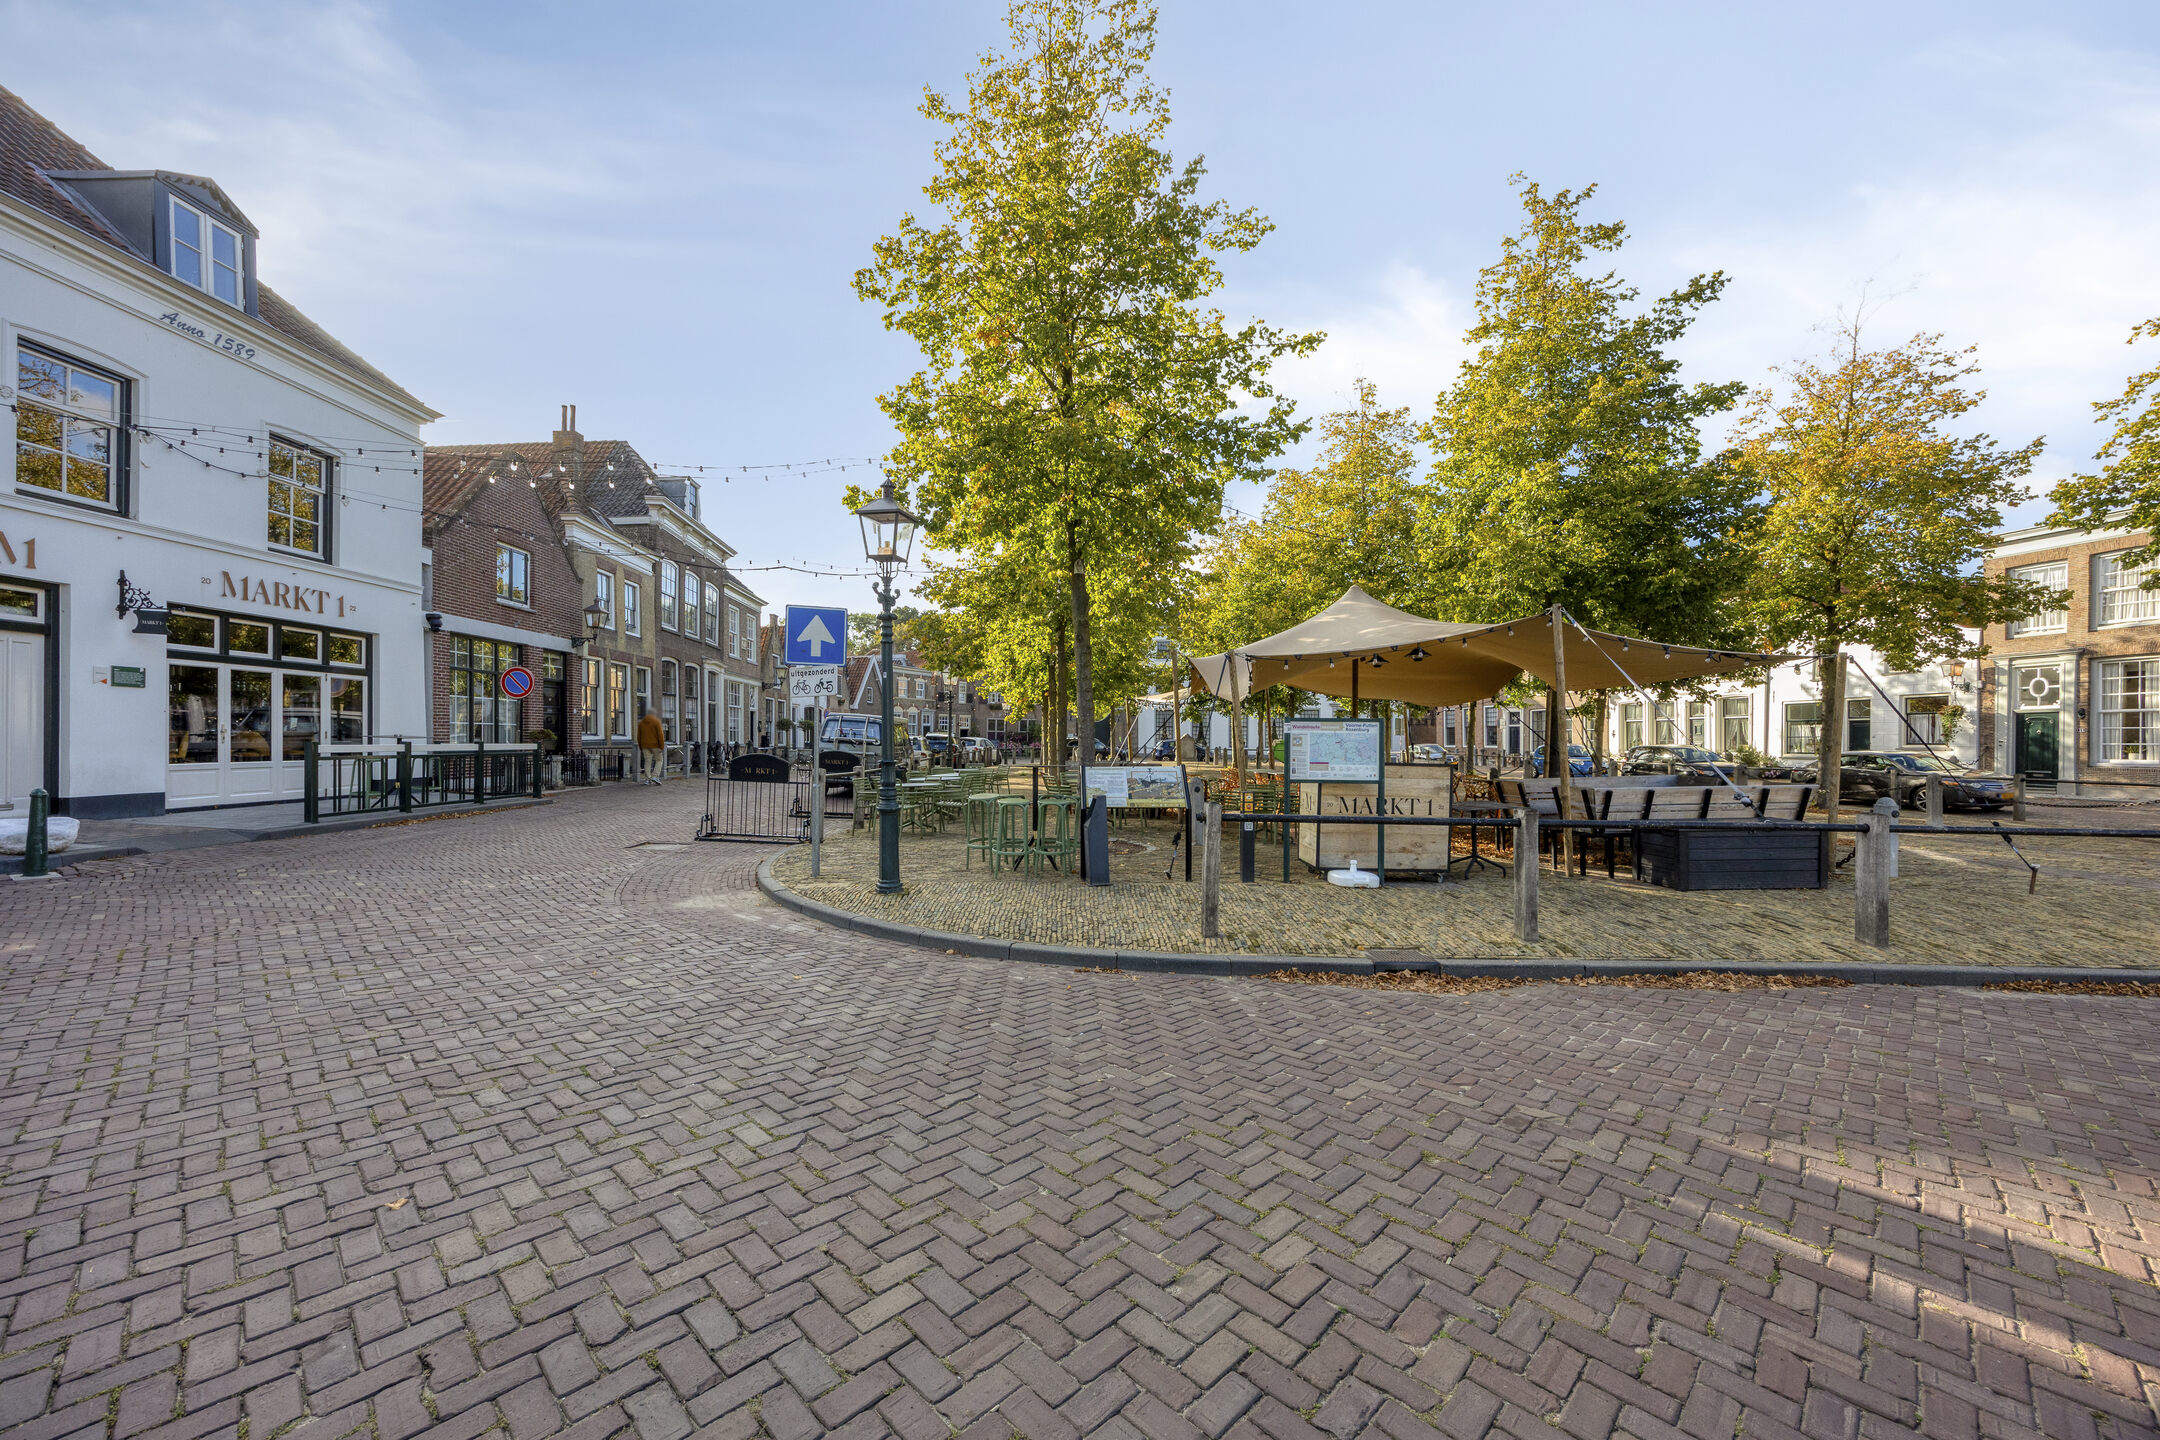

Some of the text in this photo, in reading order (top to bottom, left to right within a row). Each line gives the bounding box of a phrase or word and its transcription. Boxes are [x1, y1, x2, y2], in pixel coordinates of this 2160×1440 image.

[160, 312, 256, 360] Anno 1589
[201, 576, 212, 585] 20
[221, 570, 331, 614] MARKT
[338, 595, 345, 618] 1
[791, 668, 835, 678] uitgezonderd
[744, 767, 771, 775] MRKT
[1427, 798, 1433, 816] 1
